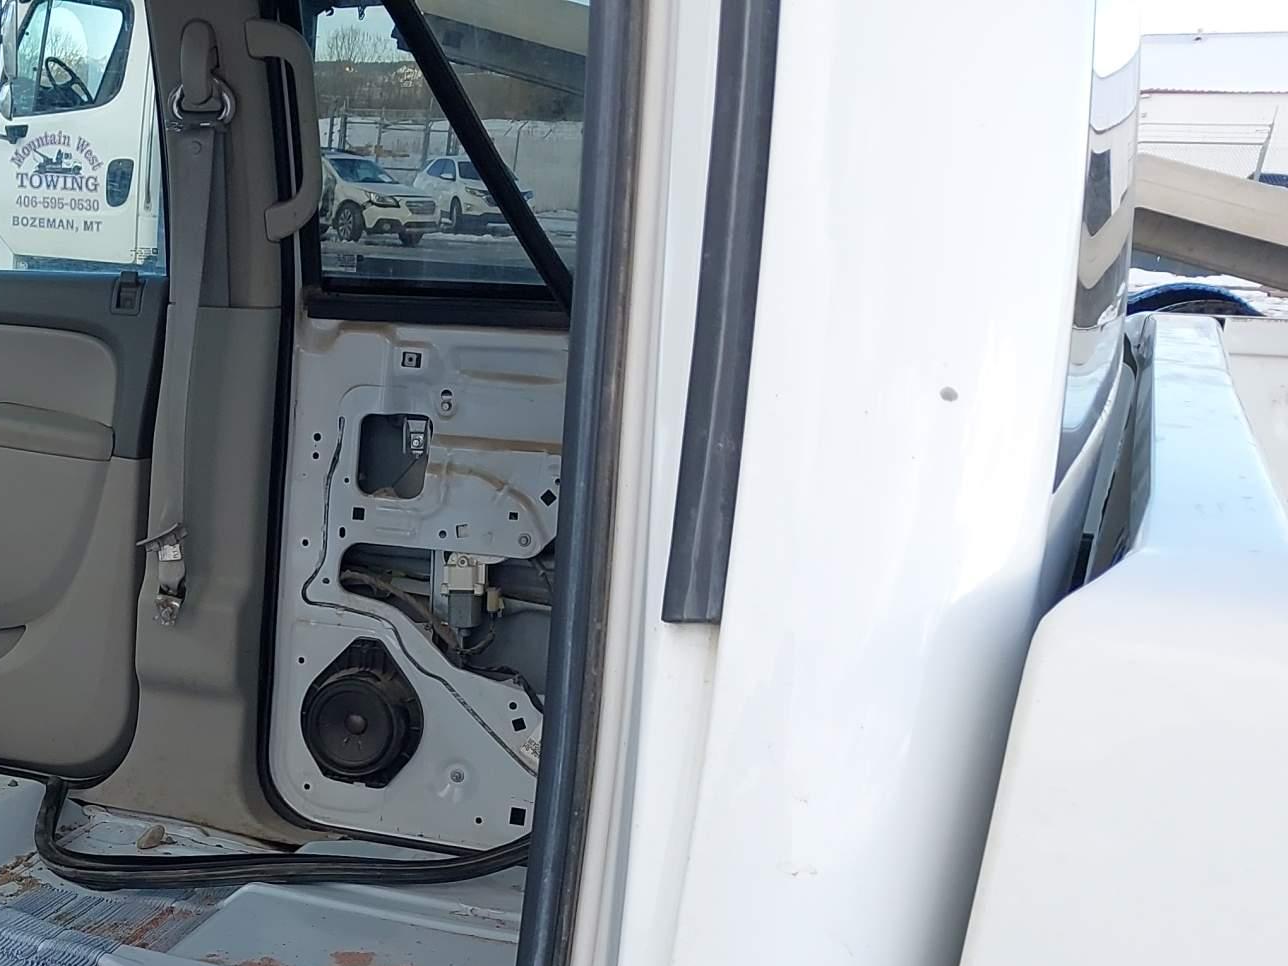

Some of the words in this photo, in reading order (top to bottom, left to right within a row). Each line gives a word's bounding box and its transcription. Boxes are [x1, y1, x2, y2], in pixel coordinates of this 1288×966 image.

[10, 130, 71, 169] Mountain
[76, 136, 104, 171] West
[16, 172, 100, 192] TOWING
[12, 215, 79, 232] BOZEMAN,
[83, 220, 103, 232] MT
